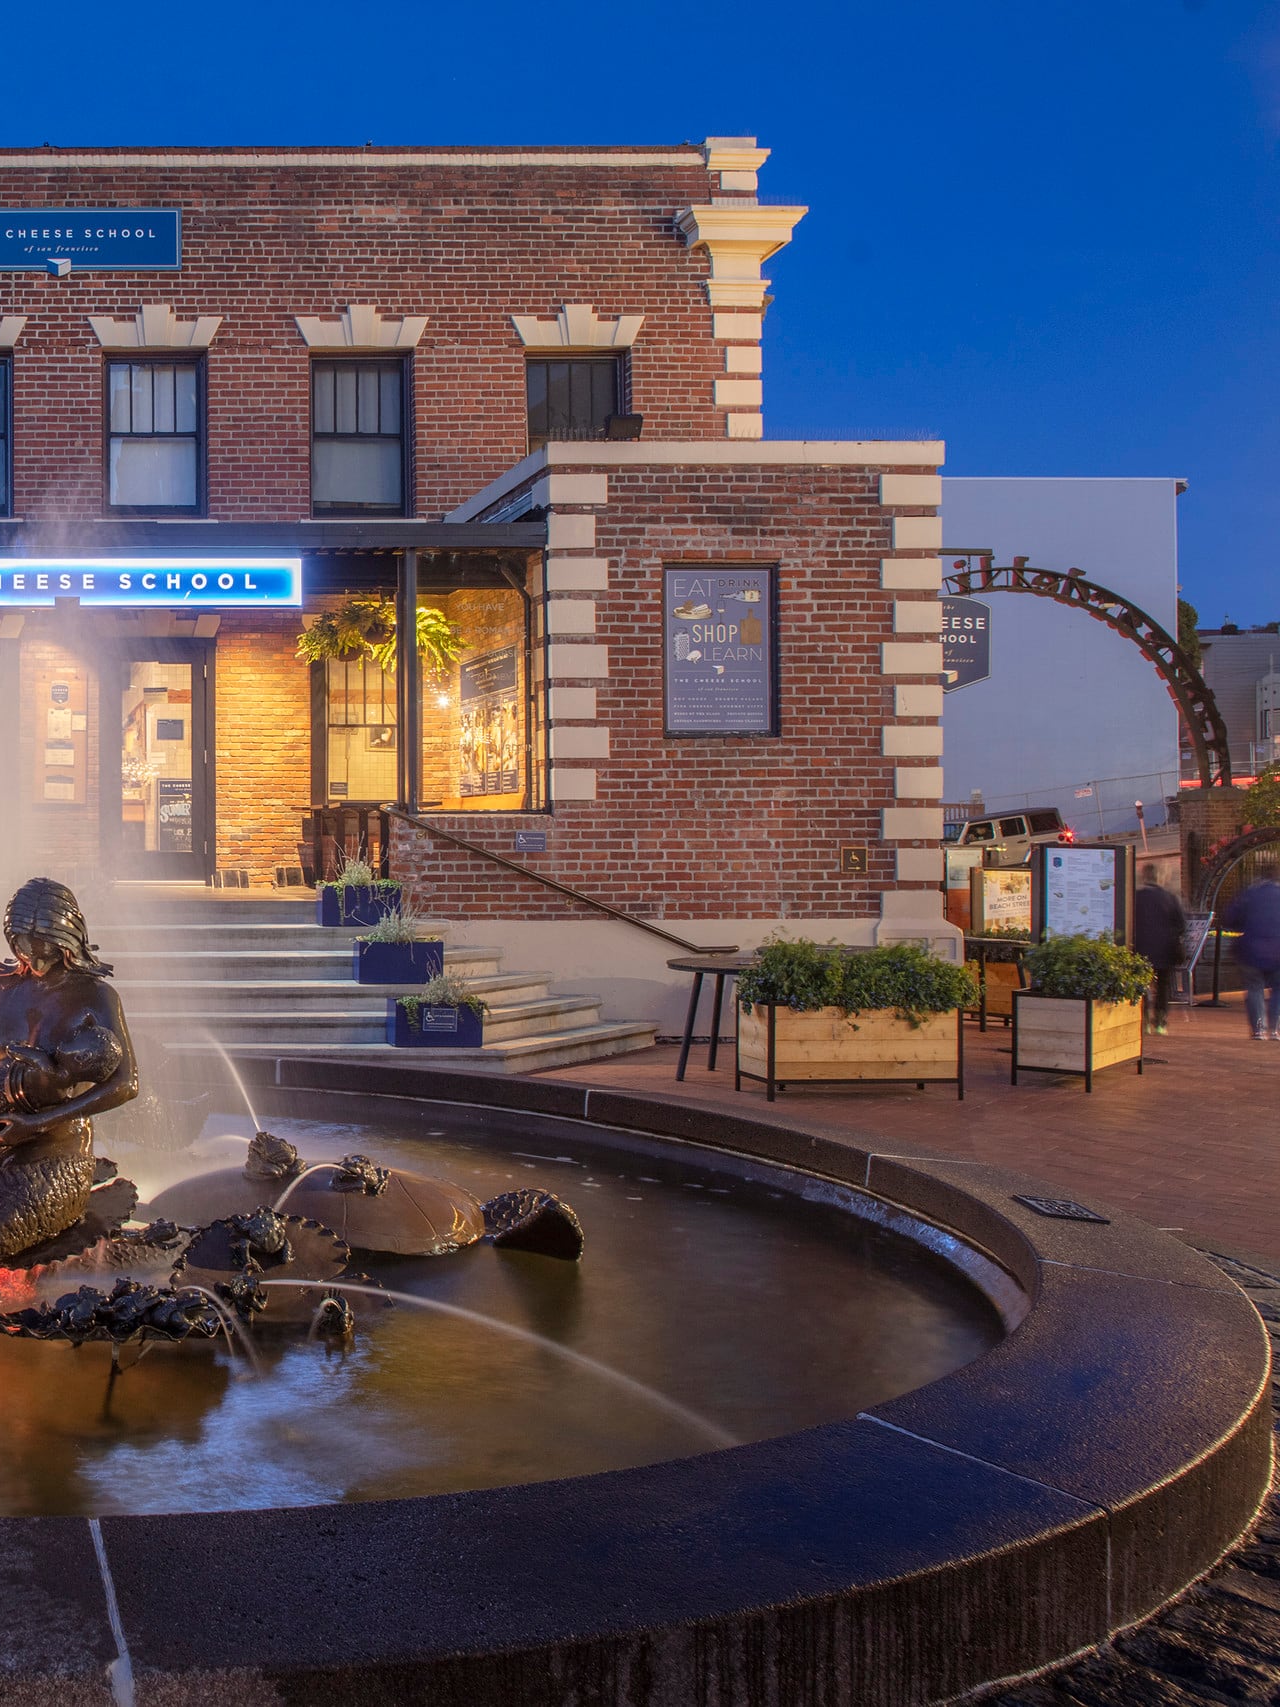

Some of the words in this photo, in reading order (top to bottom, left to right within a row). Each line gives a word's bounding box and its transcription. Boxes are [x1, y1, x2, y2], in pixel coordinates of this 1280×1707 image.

[5, 229, 74, 239] CHEESE
[84, 229, 156, 238] SCHOOL
[23, 245, 34, 254] of
[118, 573, 257, 590] SCHOOL
[673, 578, 716, 598] EAT
[718, 579, 760, 587] DRINK
[941, 617, 985, 630] EESE
[692, 624, 738, 643] SHOP
[939, 635, 977, 644] HOOL
[703, 647, 763, 662] LEARN
